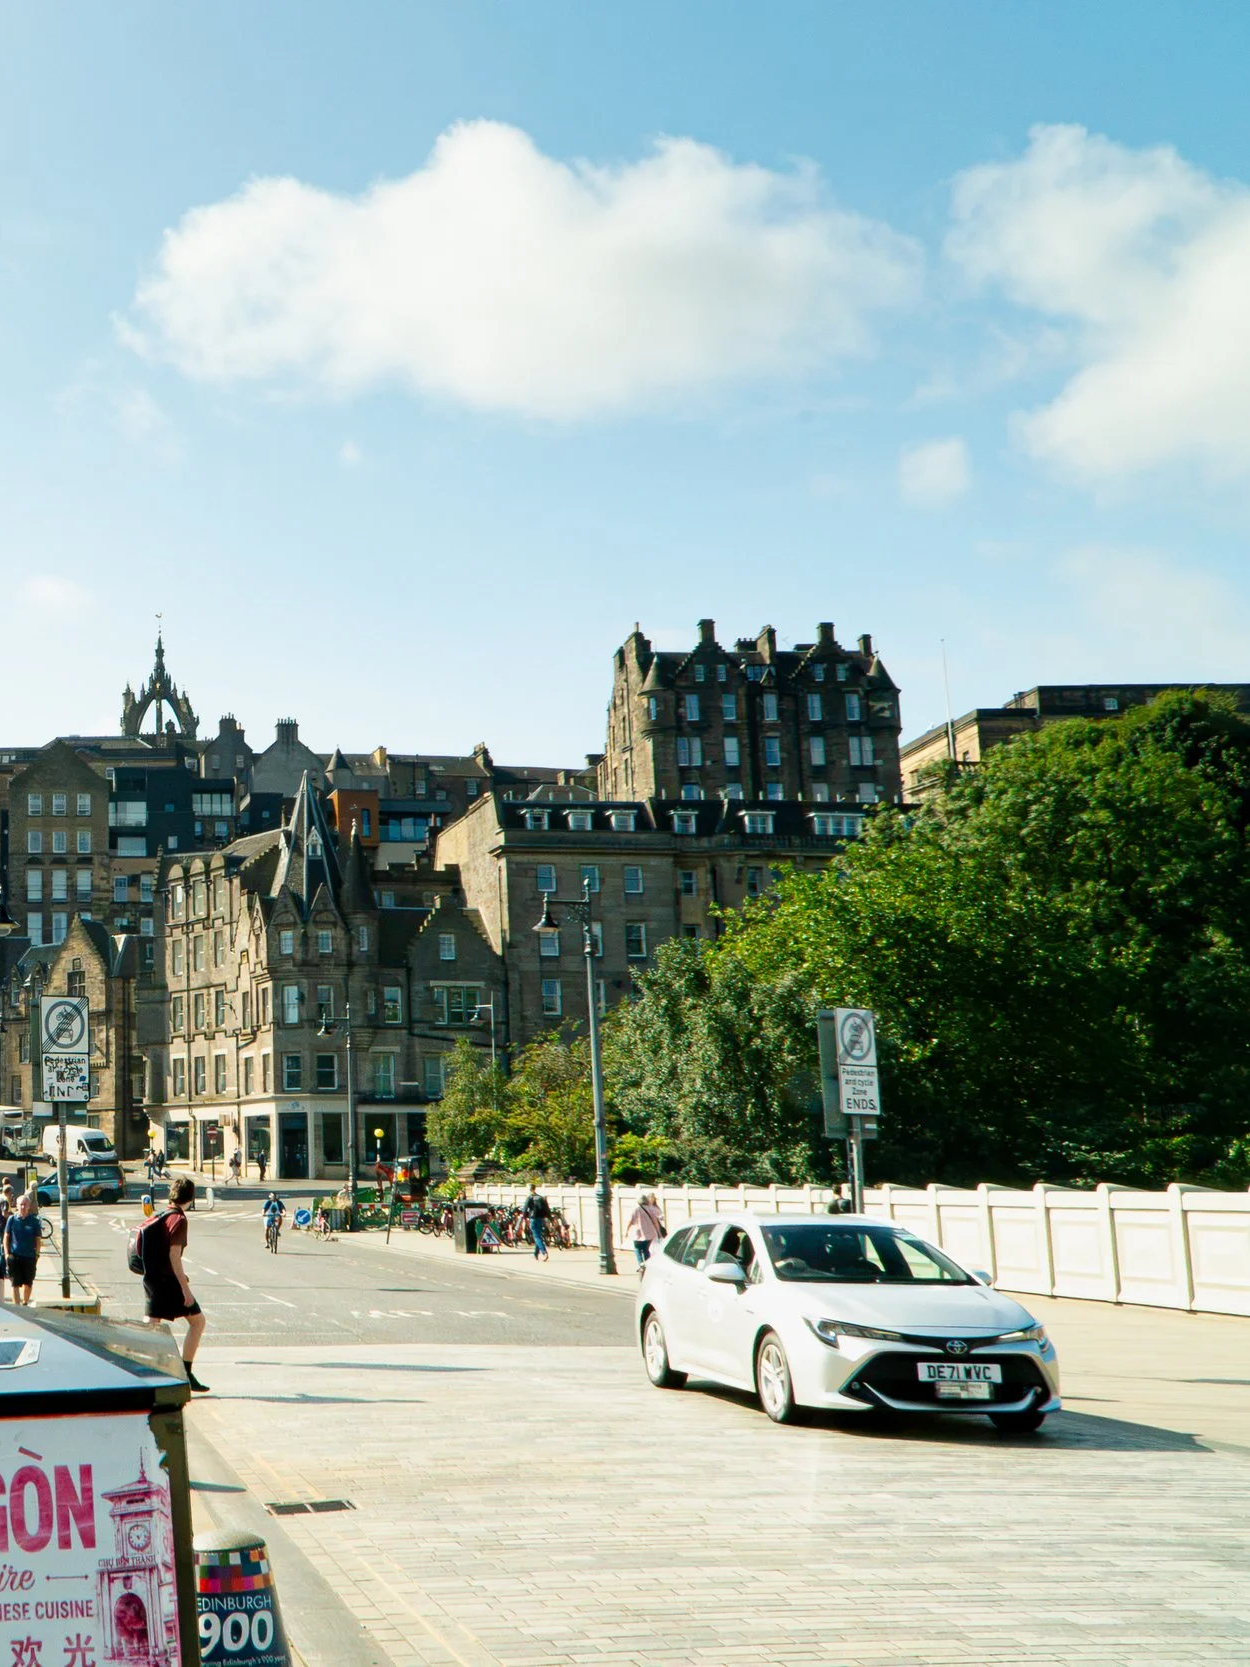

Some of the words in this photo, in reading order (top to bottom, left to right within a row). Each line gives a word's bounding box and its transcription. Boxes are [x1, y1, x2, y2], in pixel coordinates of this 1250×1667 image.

[846, 1098, 876, 1110] ENDS
[927, 1365, 960, 1379] DE71
[35, 1599, 94, 1620] CUISINE
[197, 1596, 272, 1611] EDINBURGH
[199, 1610, 274, 1657] 900
